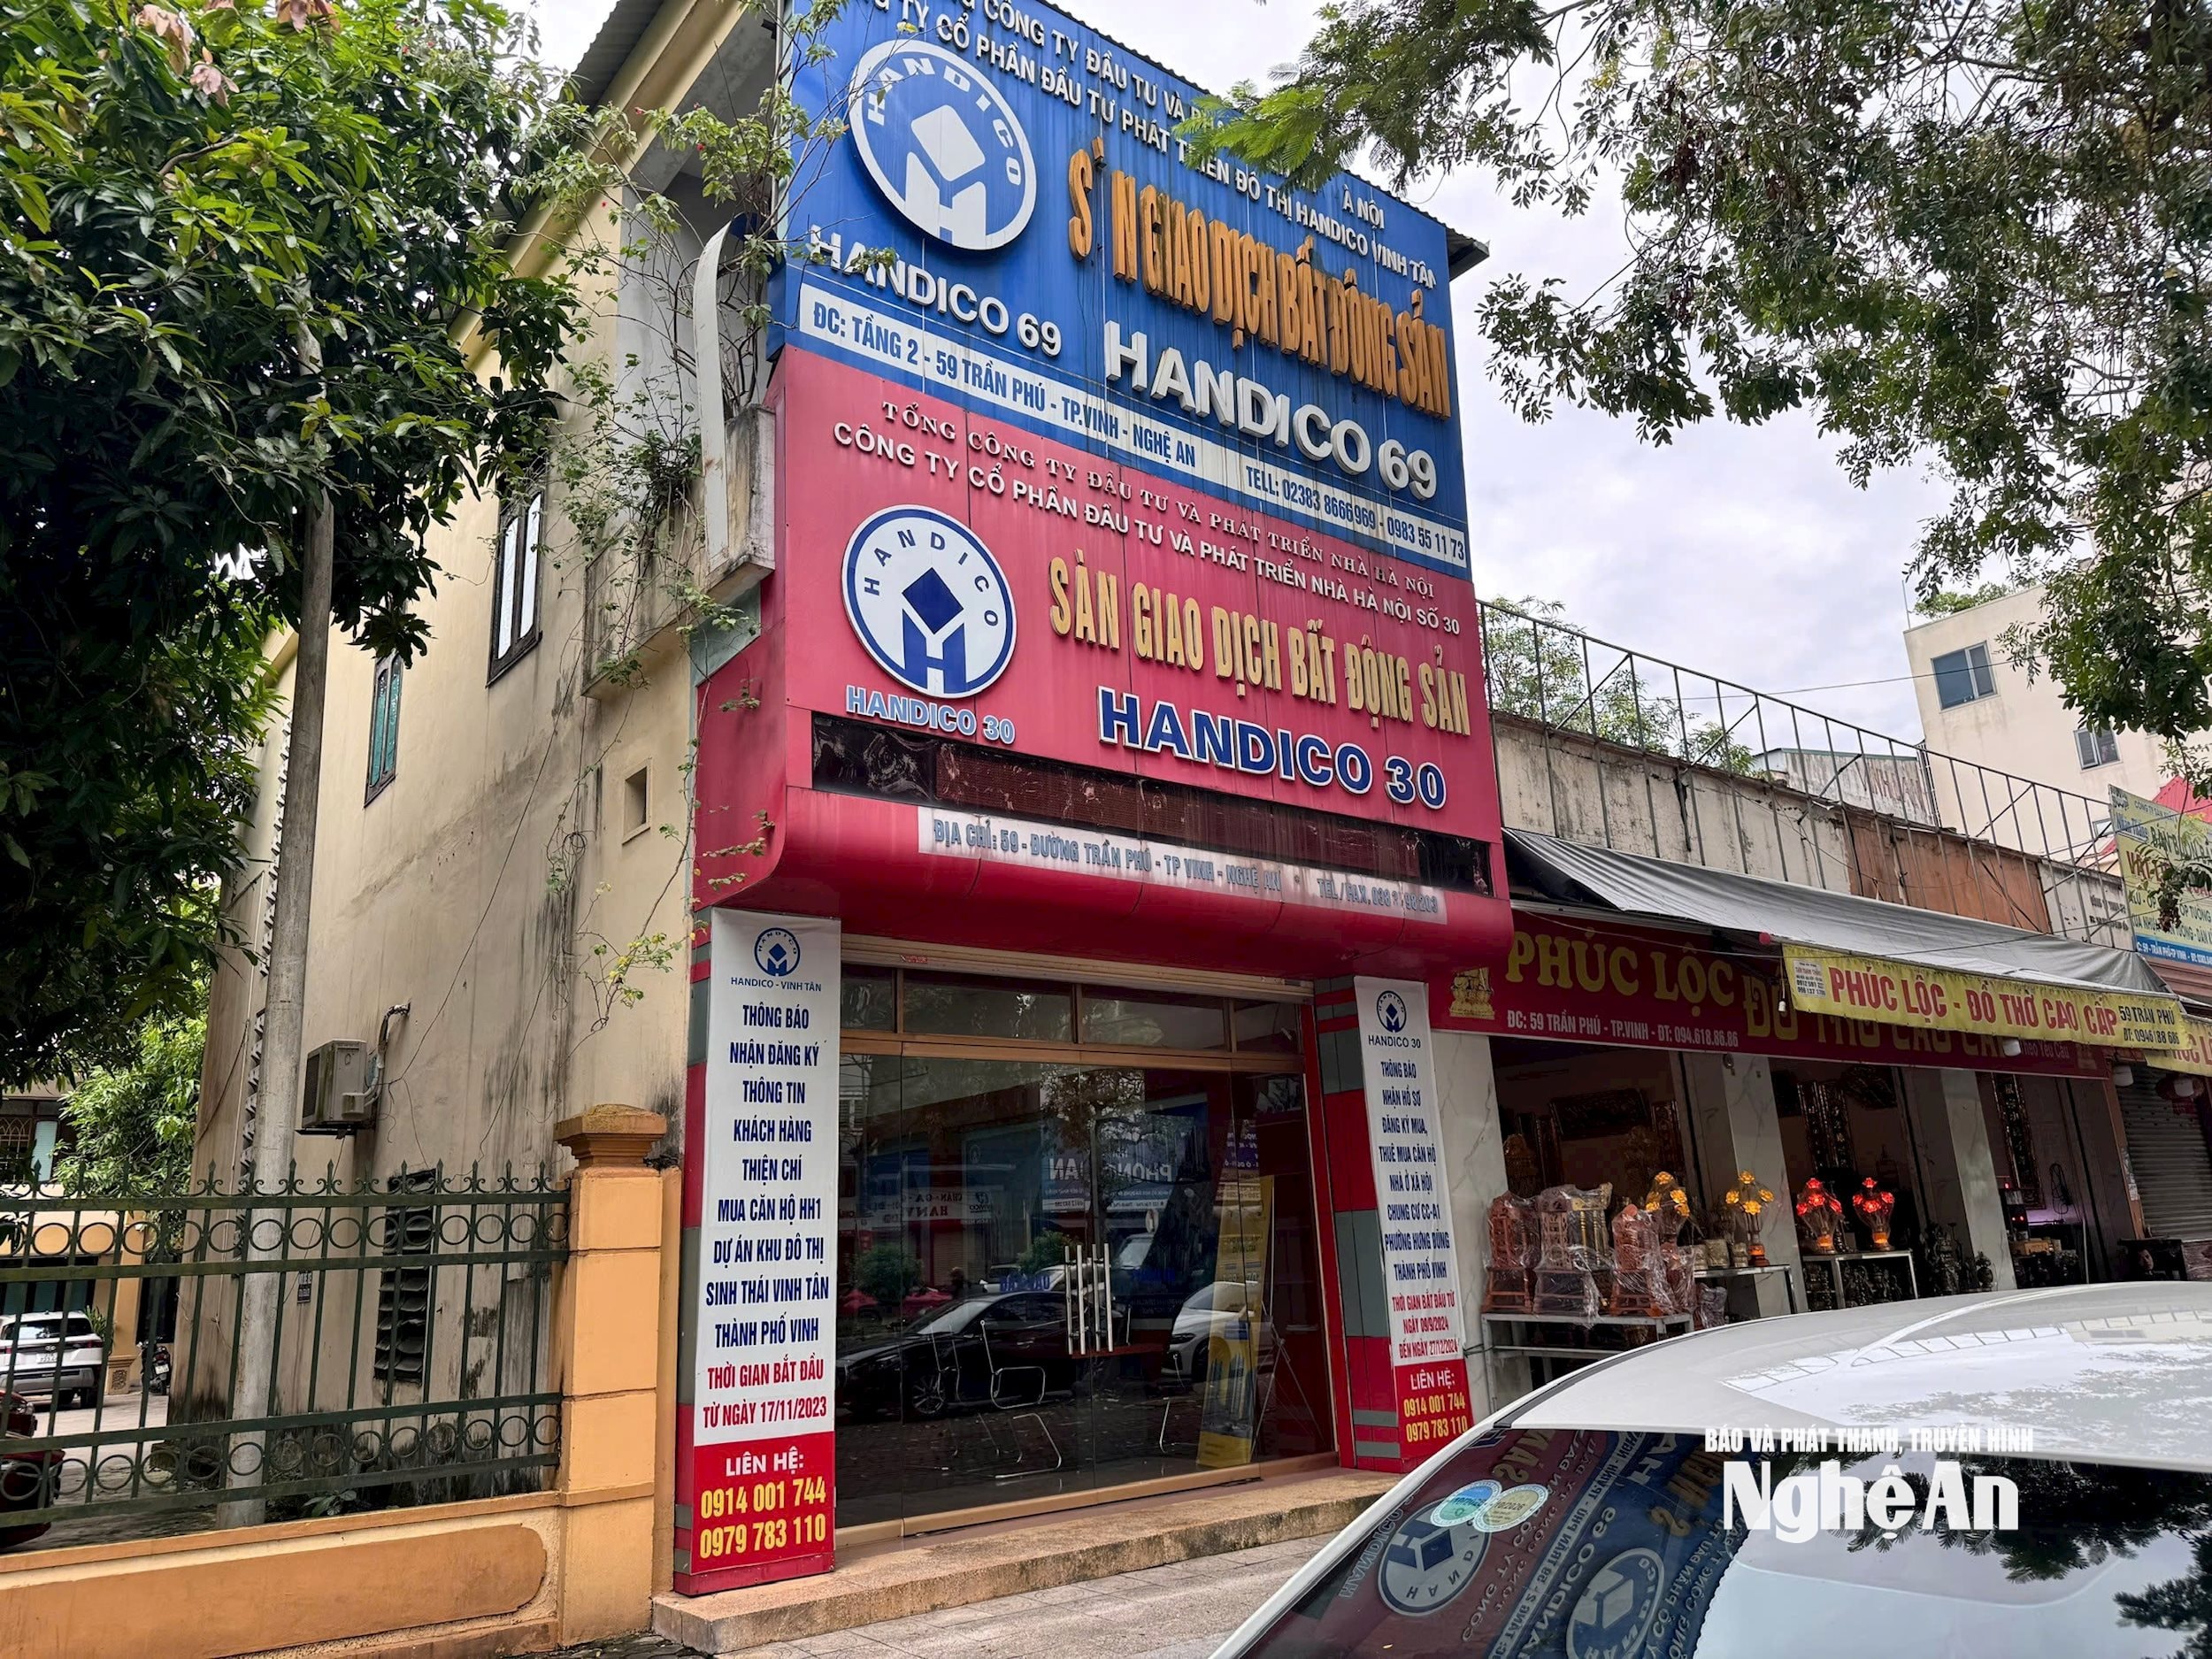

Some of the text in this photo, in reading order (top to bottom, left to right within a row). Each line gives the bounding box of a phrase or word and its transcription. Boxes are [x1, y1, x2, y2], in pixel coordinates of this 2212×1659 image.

[1050, 29, 1160, 108] TY ĐẦU TƯ
[936, 12, 970, 50] CỔ
[976, 34, 1036, 84] PHẦN
[1040, 65, 1082, 107] ĐẦU
[1087, 88, 1116, 125] TƯ
[1121, 109, 1171, 155] PHÁT
[1234, 167, 1262, 202] ĐÔ
[1265, 184, 1292, 222] THỊ
[1296, 202, 1368, 257] HANDICO
[1371, 241, 1408, 277] VINH
[1409, 260, 1436, 289] TÂN
[810, 224, 1062, 357] HANDICO 69
[1396, 288, 1451, 419] SẢN
[1103, 319, 1437, 502] HANDICO 69
[813, 301, 1465, 561] ĐC: TẦNG 2 59 TRẦN PHÚ TP.VINH NGHỆ AN TELL: 02383 8666969 0983 55 11 73
[882, 401, 1435, 601] TỔNG CÔNG TY TƯ VÀ PHÁT TRIỂN NHÀ HÀ NỘI
[833, 421, 1460, 635] CÔNG TY CỔ PHẦN ĐẦU TƯ VÀ PHÁT TRIỂN NHÀ HÀ NỘI SỐ 30
[1048, 548, 1472, 736] SÀN GIAO DỊCH BẤT ĐỘNG SẢN
[846, 684, 1017, 745] HANDICO 30
[1097, 685, 1448, 810] HANDICO 30
[933, 818, 1181, 877] ĐỊA 59 ĐƯỜNG TRẦN PHÚ TP
[731, 977, 774, 988] HANDICO
[1505, 926, 1639, 996] PHÚC
[1649, 942, 1734, 1018] LỘC
[742, 1002, 810, 1029] THÔNG BÁO
[1828, 966, 1899, 1011] PHÚC
[1901, 975, 1947, 1023] LỘC
[1965, 980, 1997, 1024] ĐỒ
[1999, 989, 2039, 1028] THỜ
[2042, 998, 2079, 1032] CAO
[2083, 996, 2118, 1037] CẤP
[1368, 1034, 1409, 1048] HANDICO
[1507, 1009, 1739, 1048] ĐC: 59 TRẦN PHÚ TP.VINH 094.618.86.86
[729, 1039, 819, 1069] NHẬN ĐĂNG KÝ
[742, 1076, 806, 1104] THÔNG TIN
[733, 1115, 811, 1142] KHÁCH HÀNG
[742, 1154, 803, 1186] THIỆN CHÍ
[718, 1194, 821, 1225] MUA CĂN HỘ HH1
[713, 1233, 824, 1269] DỰ ÁN KHU ĐÔ THỊ
[1385, 1228, 1411, 1251] PHƯỜNG
[706, 1272, 829, 1306] SINH THÁI VINH TÂN
[1392, 1293, 1406, 1311] THỜI
[715, 1311, 818, 1348] THÀNH PHỐ VINH
[708, 1352, 825, 1390] THỜI GIAN BẮT ĐẦU
[1437, 1367, 1455, 1389] HỆ:
[703, 1395, 827, 1429] TỪ NGÀY 17/11/2023
[1403, 1397, 1427, 1417] 0914
[1406, 1415, 1468, 1443] 0979 110
[726, 1446, 804, 1477] LIÊN HỆ:
[701, 1476, 826, 1519] 0914 001 744
[699, 1513, 826, 1559] 0979 783 110
